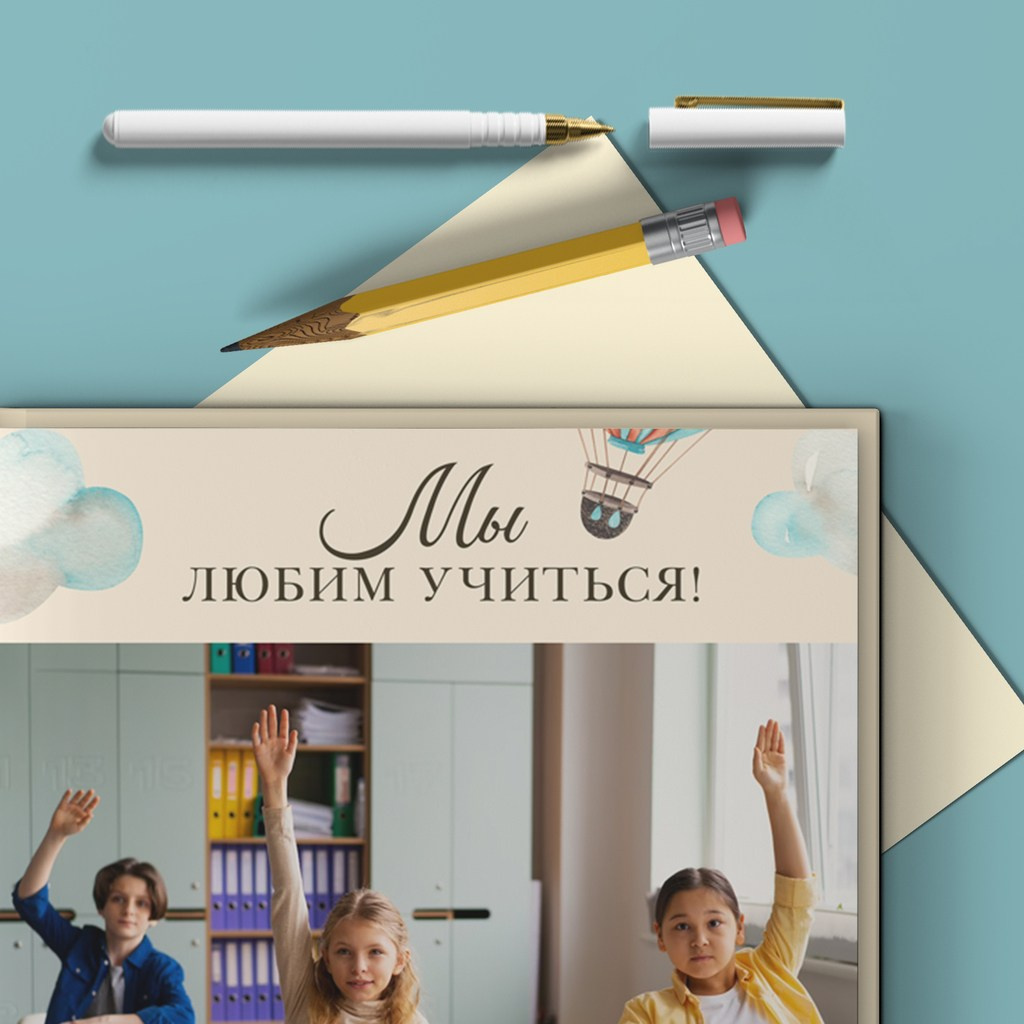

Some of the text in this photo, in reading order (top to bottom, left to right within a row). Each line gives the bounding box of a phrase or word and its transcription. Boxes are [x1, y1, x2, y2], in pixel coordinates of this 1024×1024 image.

[318, 461, 529, 561] Мы
[181, 566, 700, 603] ЛЮБИМ УЧИТЬСЯ!
